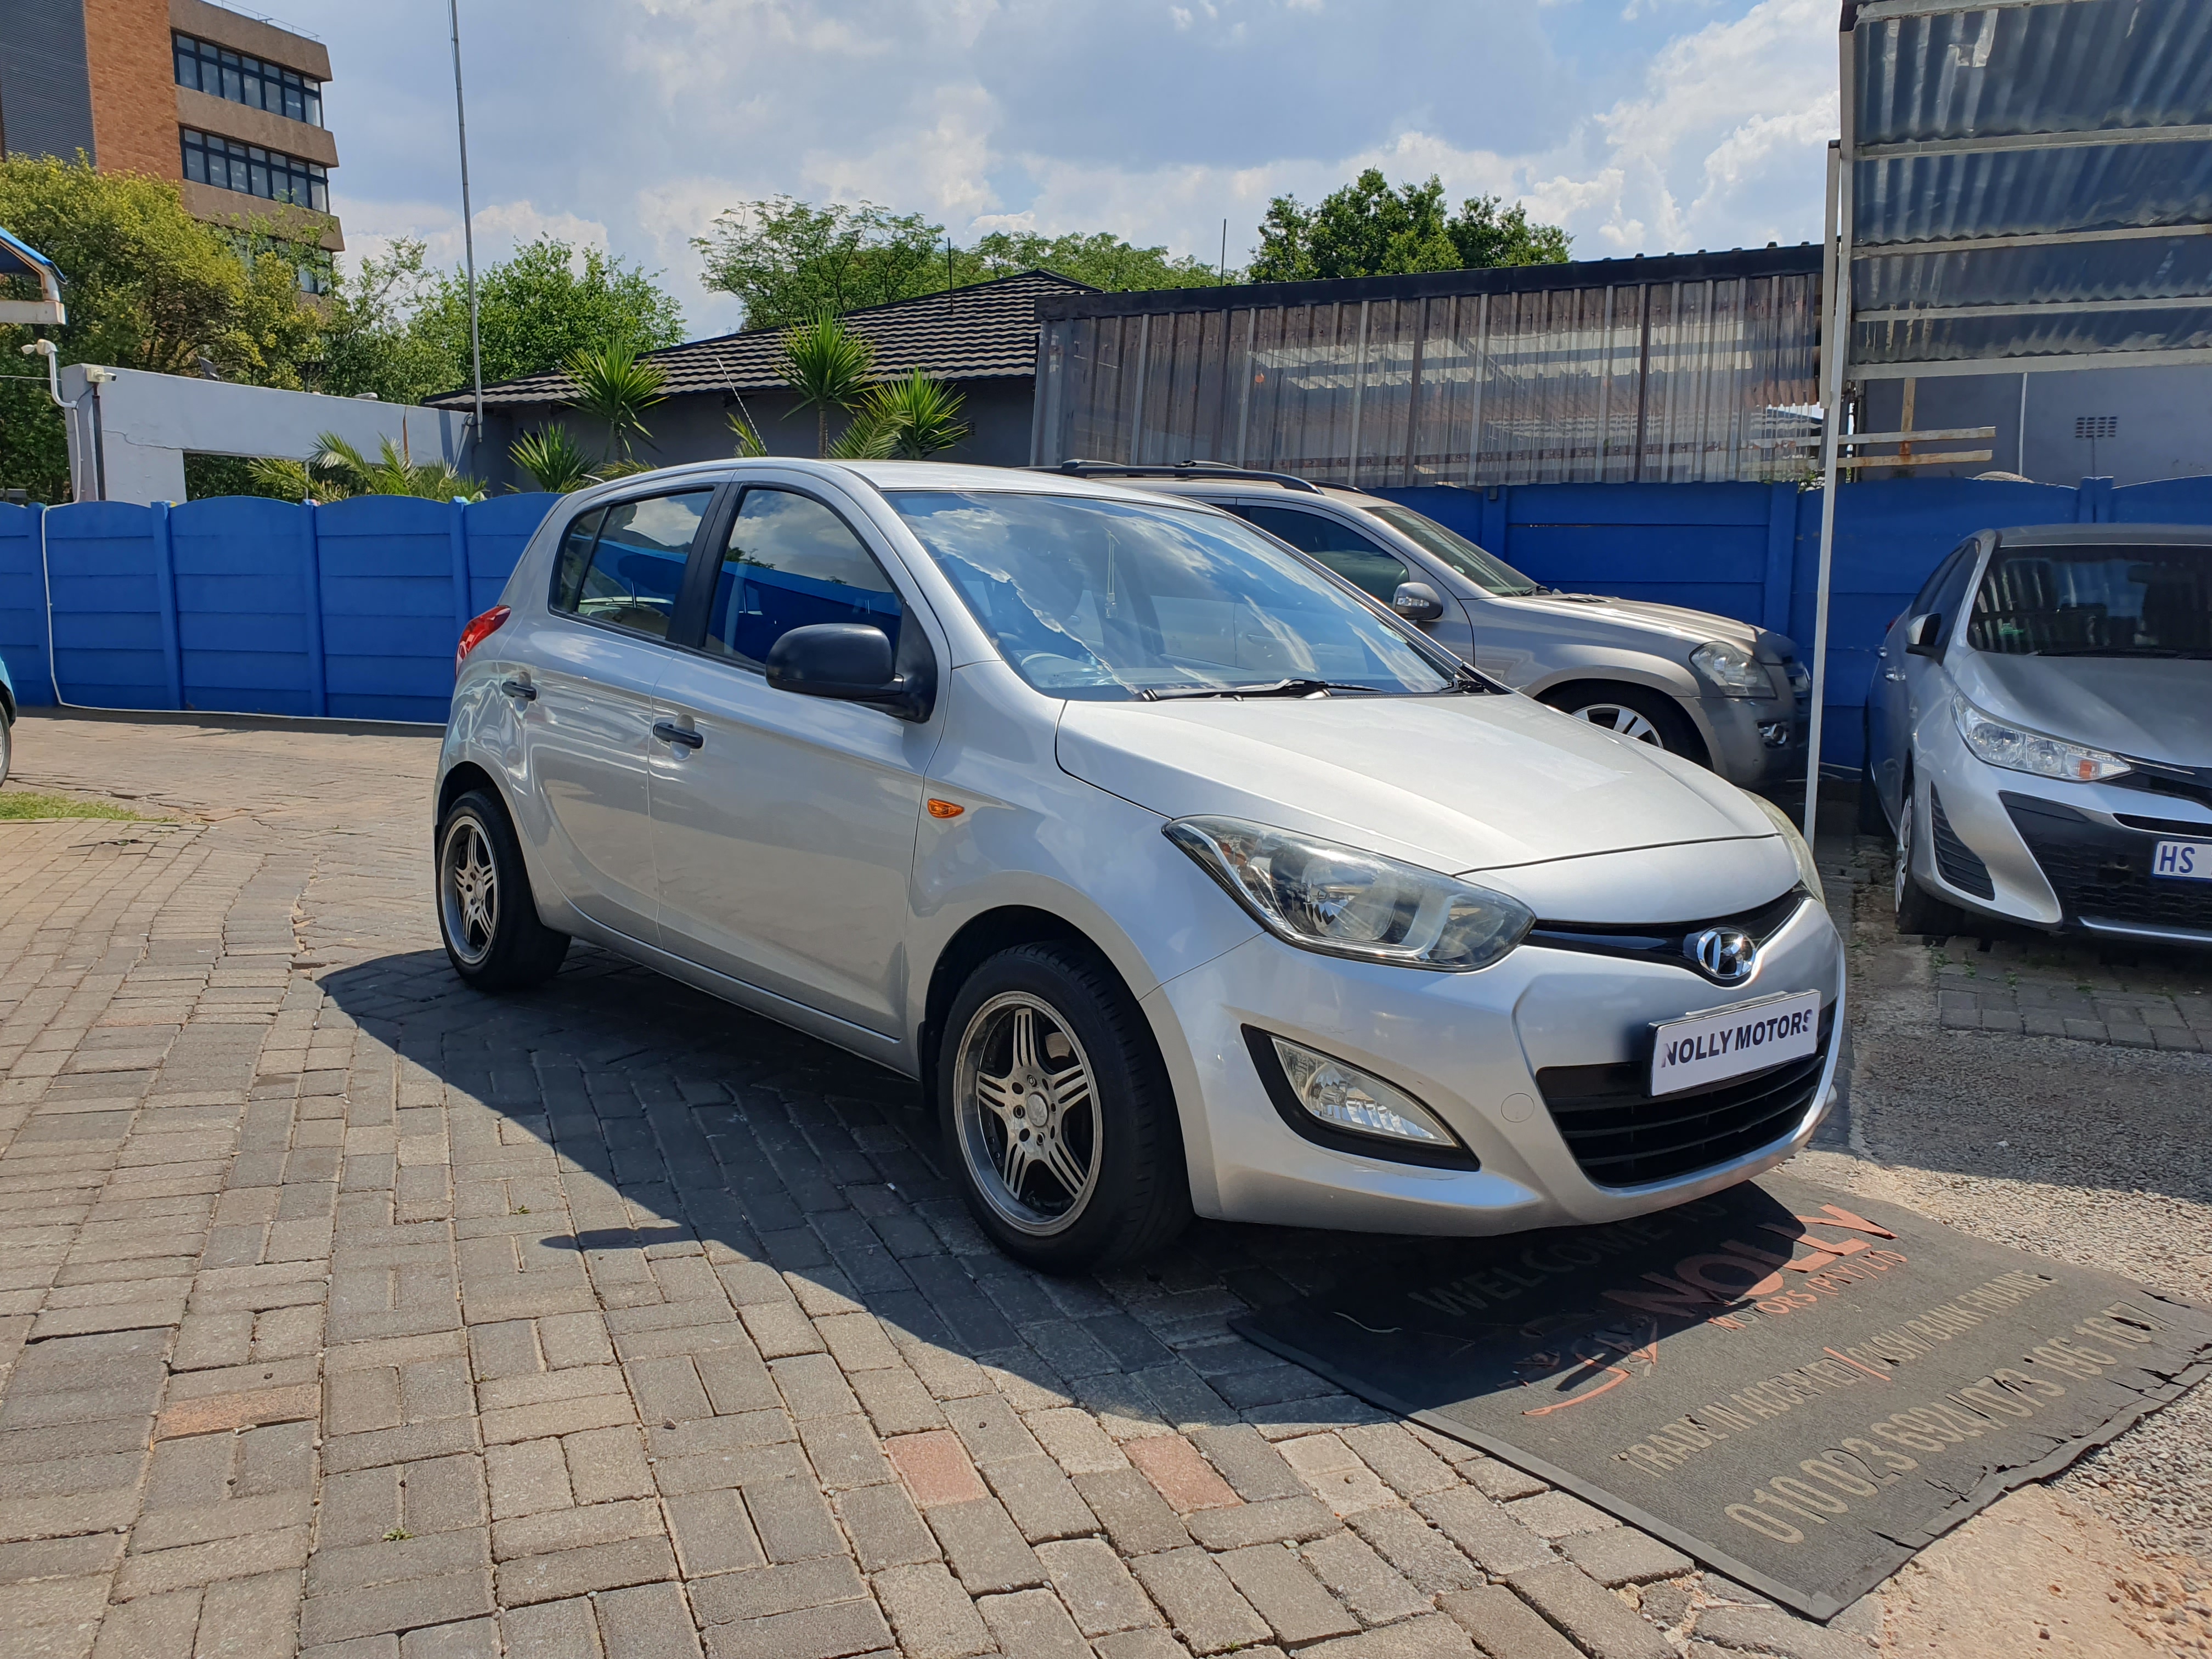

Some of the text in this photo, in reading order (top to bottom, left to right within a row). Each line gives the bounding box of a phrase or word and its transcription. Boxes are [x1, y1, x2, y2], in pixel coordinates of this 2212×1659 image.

[2159, 845, 2196, 874] HS
[1407, 1215, 1673, 1317] WELCOME
[1600, 1202, 1898, 1317] NOLLY
[1706, 1250, 1908, 1333] MOTORS (PTY) LTD
[1609, 1414, 1730, 1479] TRADE
[1697, 1401, 1758, 1432] IN
[1955, 1269, 2059, 1314] FINANCE
[1723, 1476, 1849, 1544] 010
[1799, 1437, 1920, 1497] 023
[2021, 1336, 2118, 1381] 196
